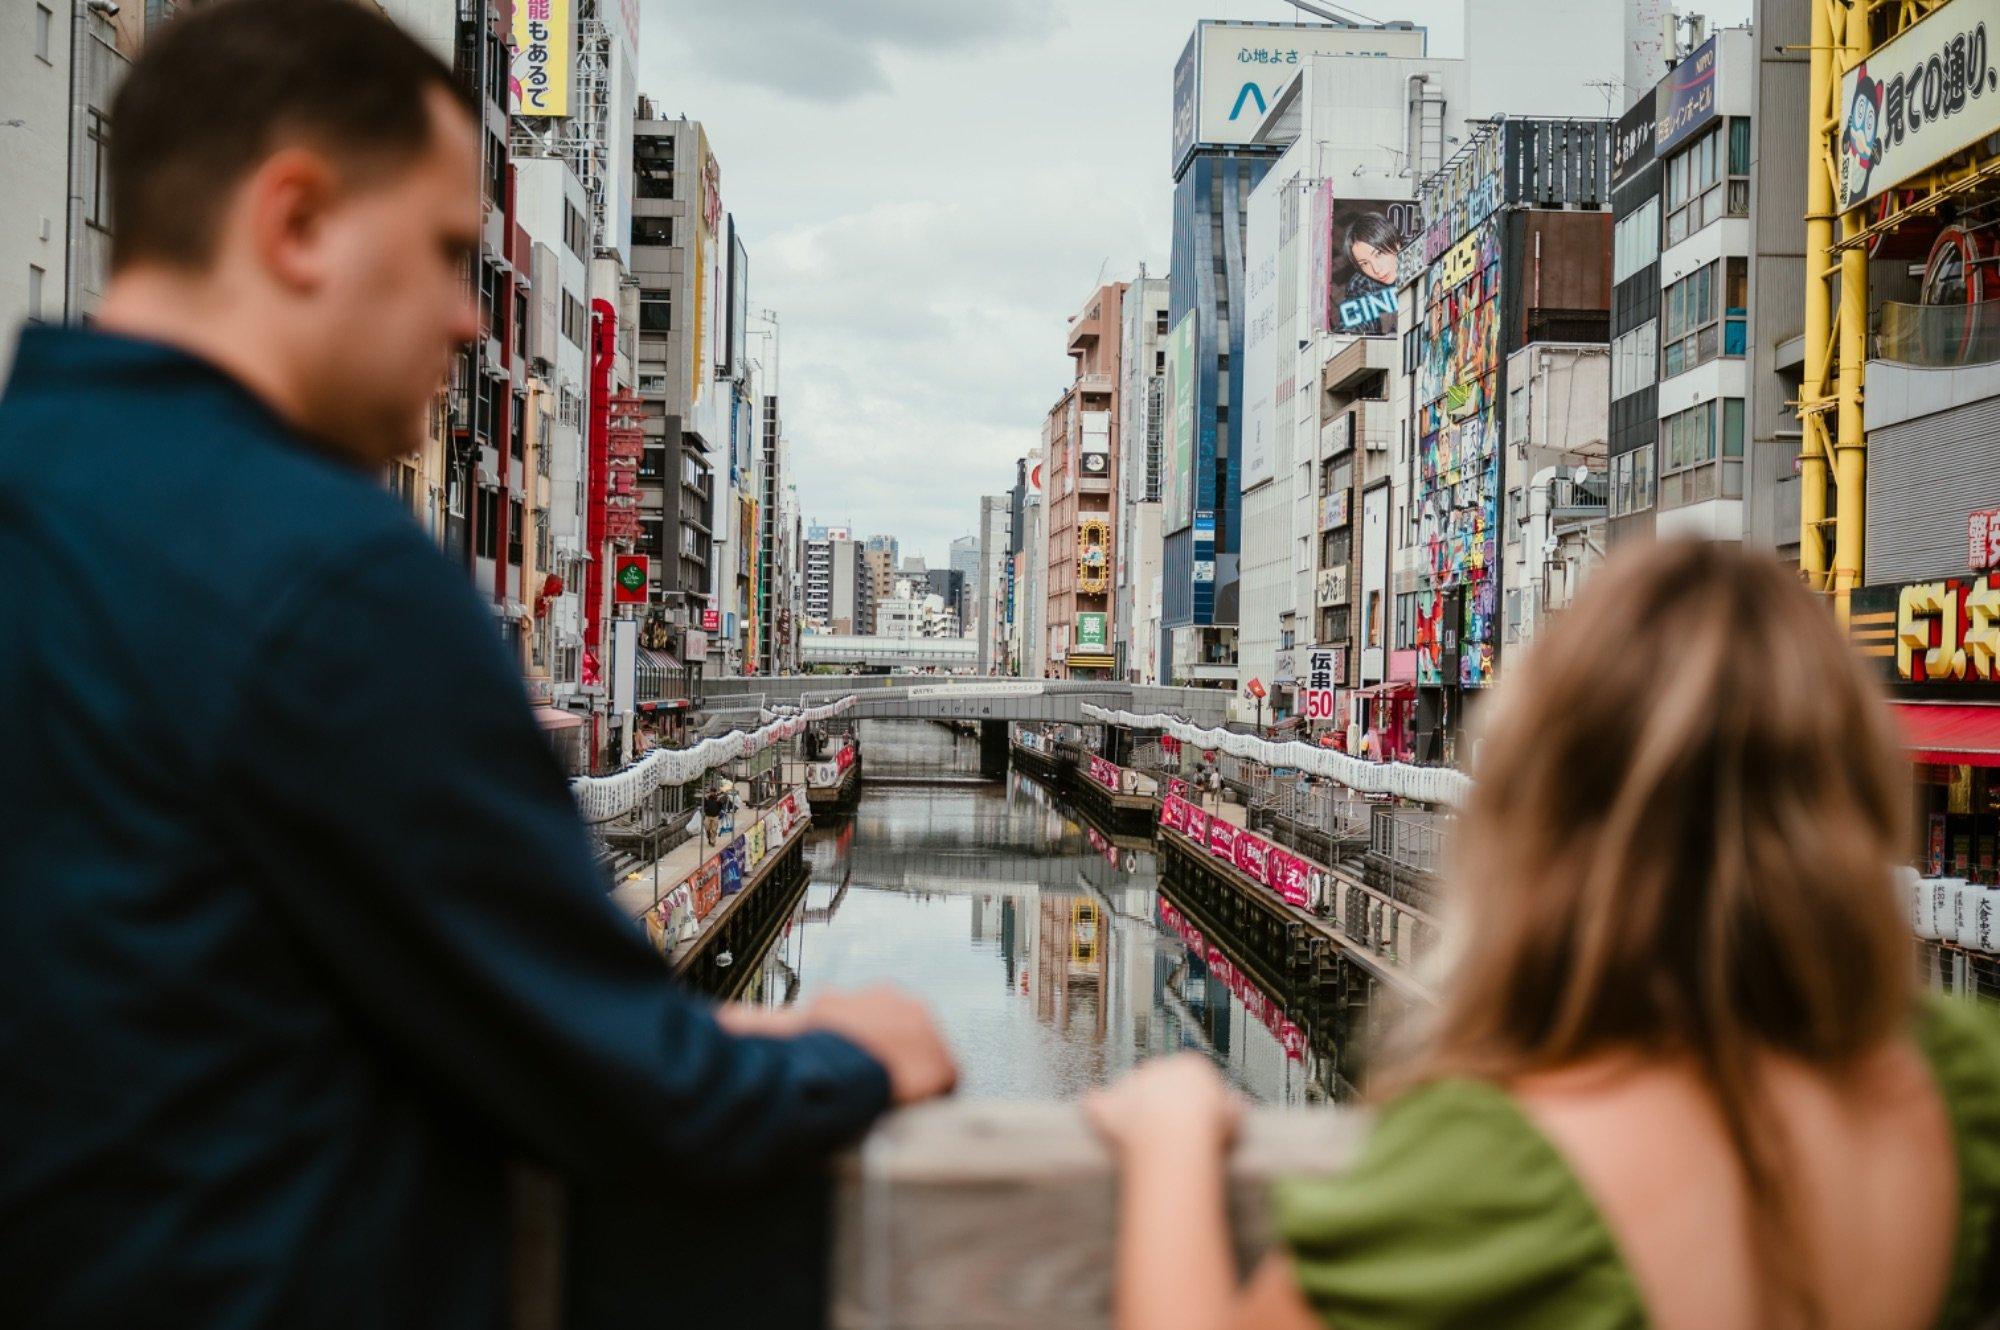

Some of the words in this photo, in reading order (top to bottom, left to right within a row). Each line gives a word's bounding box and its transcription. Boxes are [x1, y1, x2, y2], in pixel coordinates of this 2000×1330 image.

[1237, 48, 1298, 64] 心地よさ
[1884, 22, 1998, 152] 見ての通り、
[1340, 286, 1398, 327] CIN
[1311, 653, 1331, 690] 伝串
[1309, 691, 1333, 718] 50
